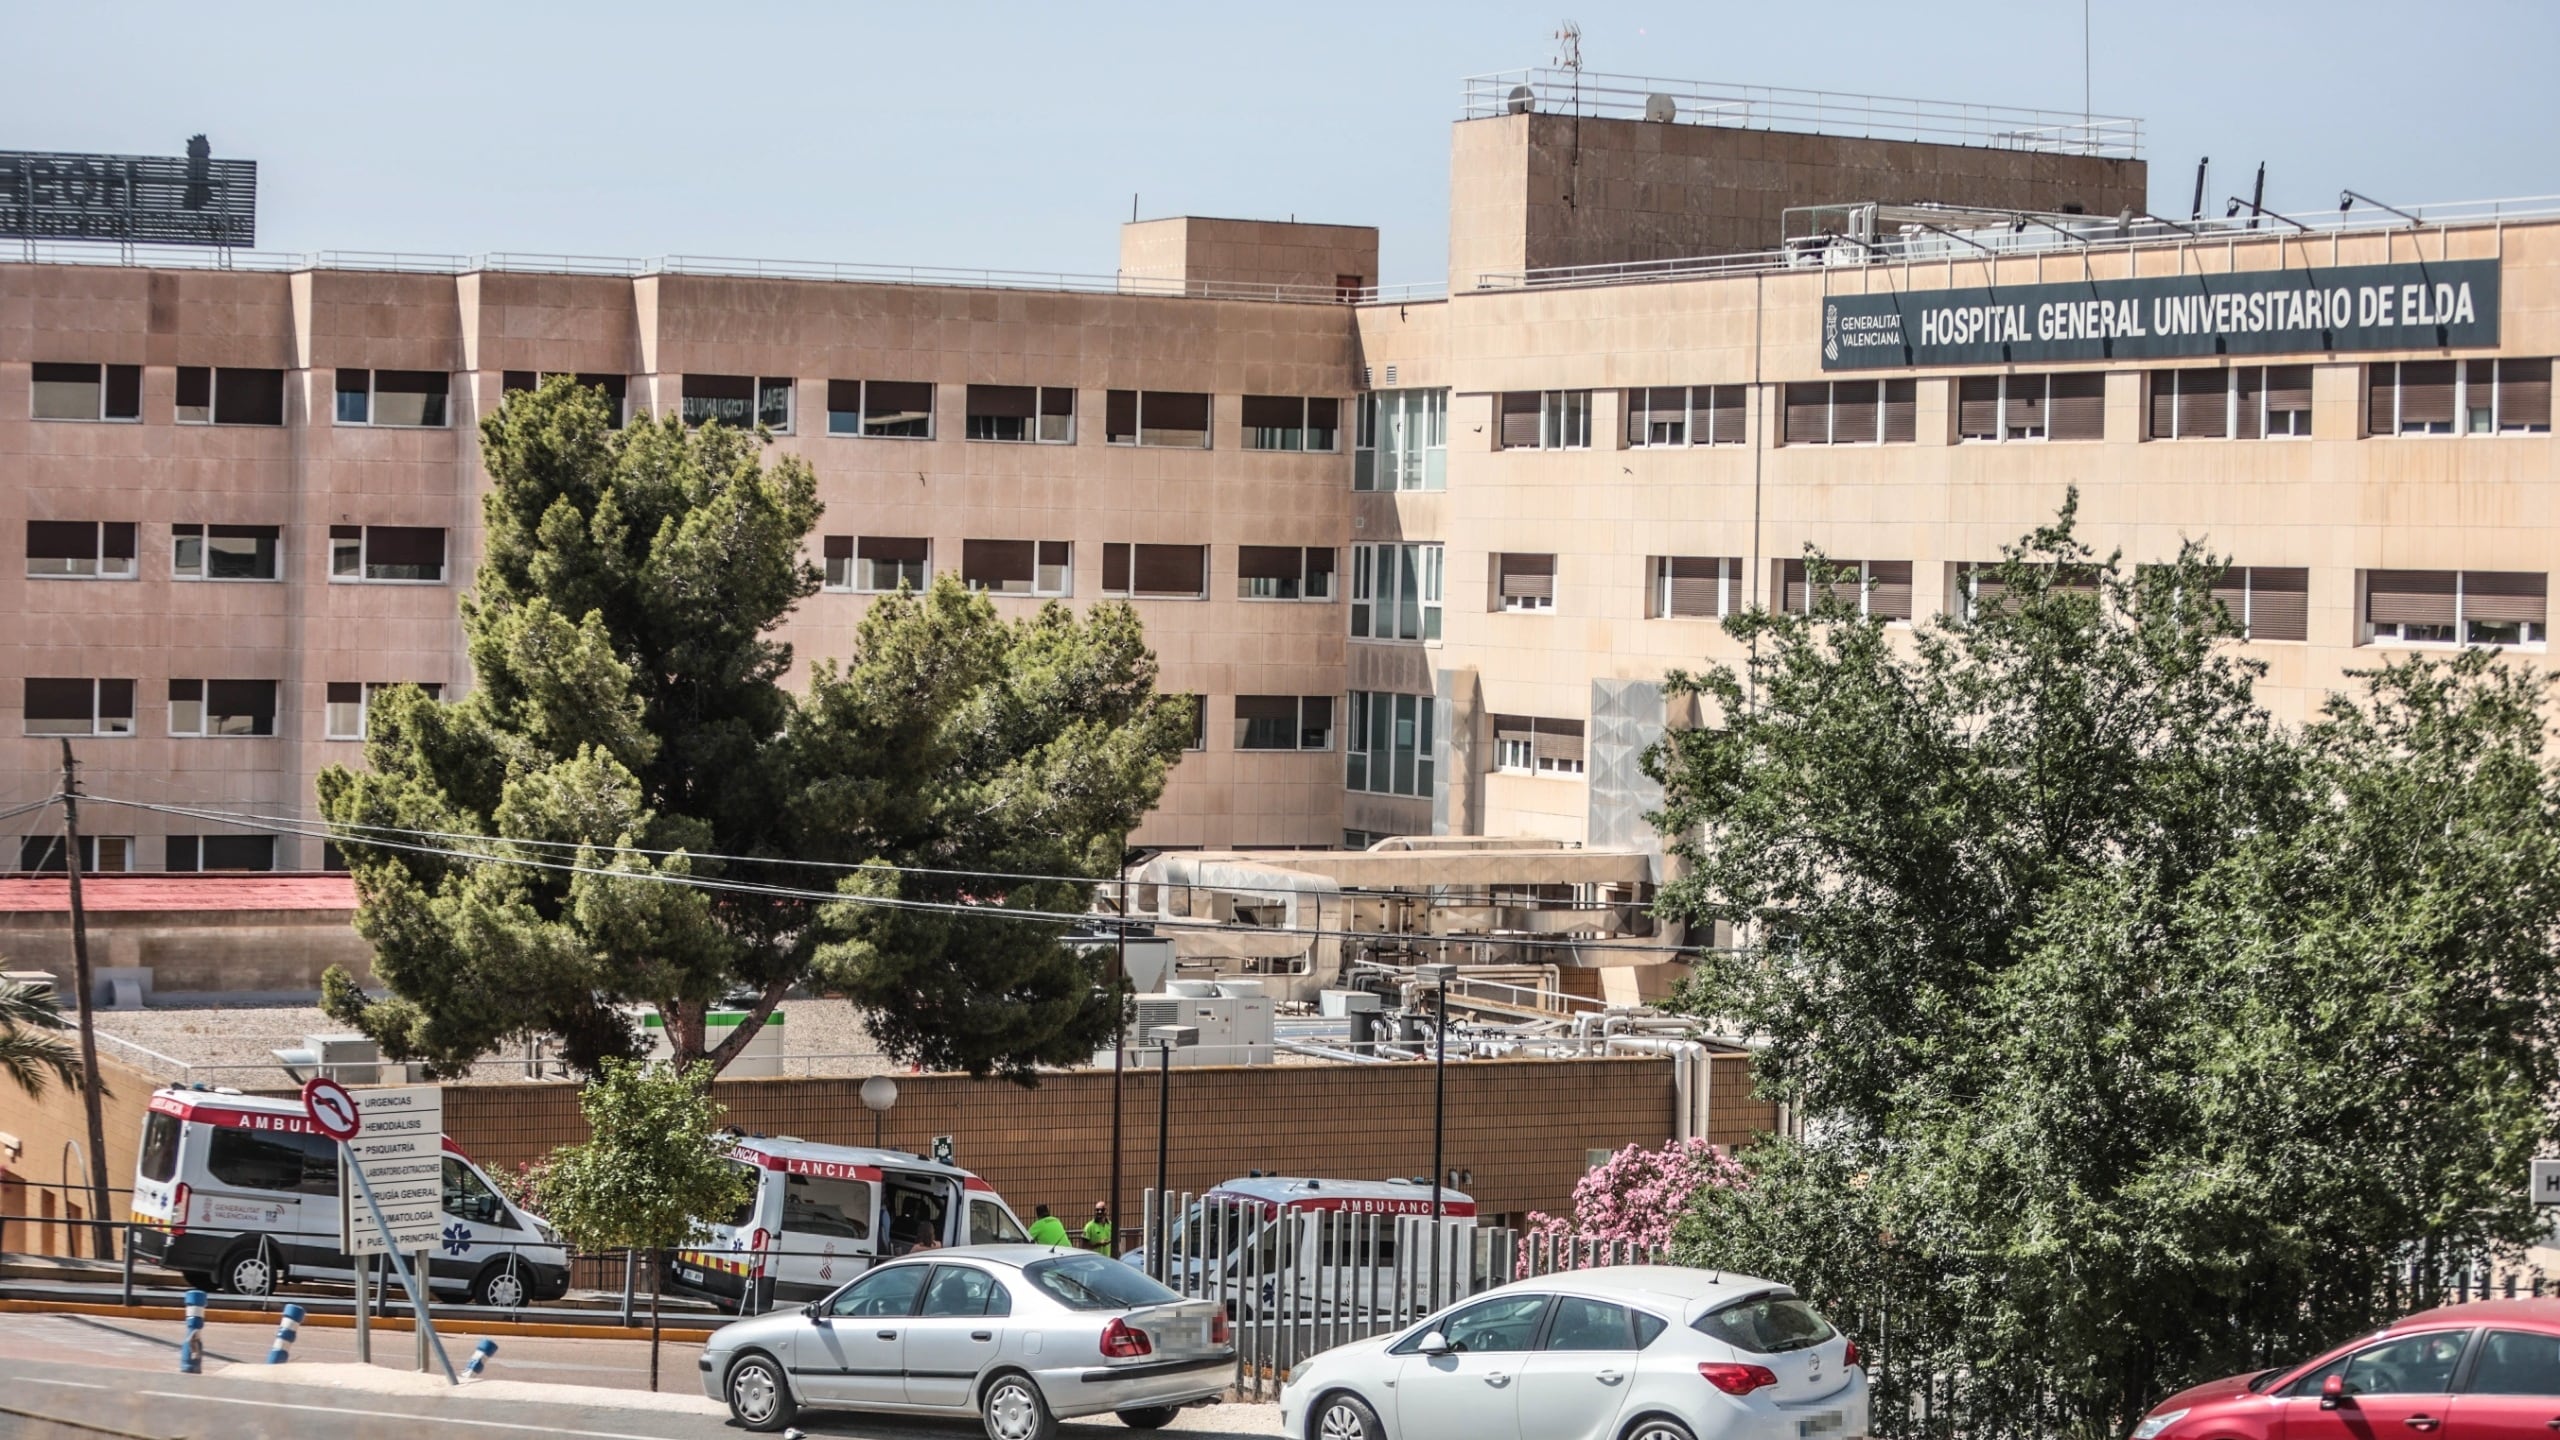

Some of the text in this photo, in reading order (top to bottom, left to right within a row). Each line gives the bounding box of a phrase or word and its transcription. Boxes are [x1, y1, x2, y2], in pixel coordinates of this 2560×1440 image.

[1921, 281, 2475, 346] HOSPITAL GENERAL UNIVERSITARIO DE ELDA
[1841, 314, 1902, 330] GENERALITAT
[1842, 331, 1900, 347] VALENCIANA
[365, 1096, 412, 1108] URGENCIAS
[239, 1115, 324, 1134] AMBUL
[366, 1142, 415, 1154] PSIQUIATRÍA
[726, 1147, 759, 1162] ANCIA
[787, 1159, 856, 1179] LANCIA
[374, 1187, 438, 1200] RUGÍA GENERAL
[1340, 1199, 1447, 1215] AMBULANCA
[367, 1210, 433, 1224] TUMATOLOGÍA
[367, 1231, 440, 1247] PUEA PRINCIPAL
